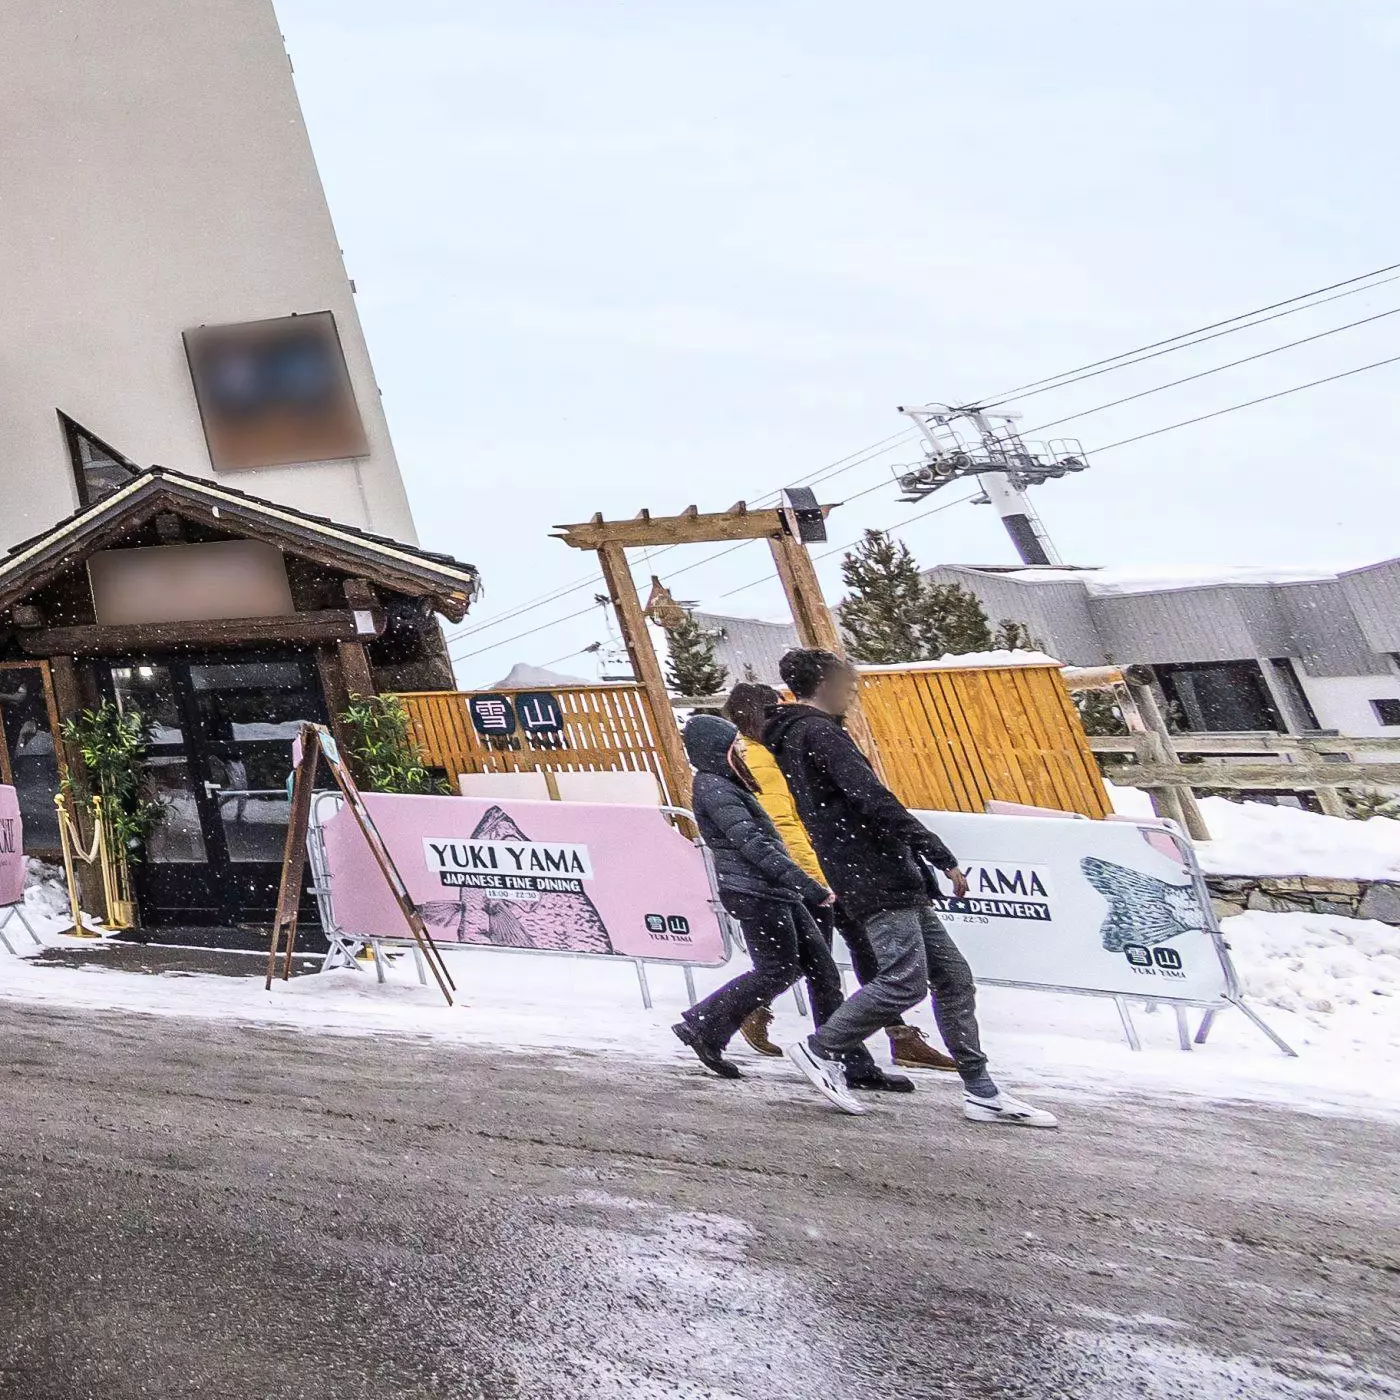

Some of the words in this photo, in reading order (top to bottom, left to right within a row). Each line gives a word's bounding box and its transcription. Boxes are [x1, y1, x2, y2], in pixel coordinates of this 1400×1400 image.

[429, 843, 498, 869] YUKI
[505, 847, 585, 873] YAMA
[443, 873, 502, 888] JAPANESE
[505, 876, 533, 890] FINE
[536, 878, 581, 892] DINING
[969, 899, 1047, 919] DELIVERY
